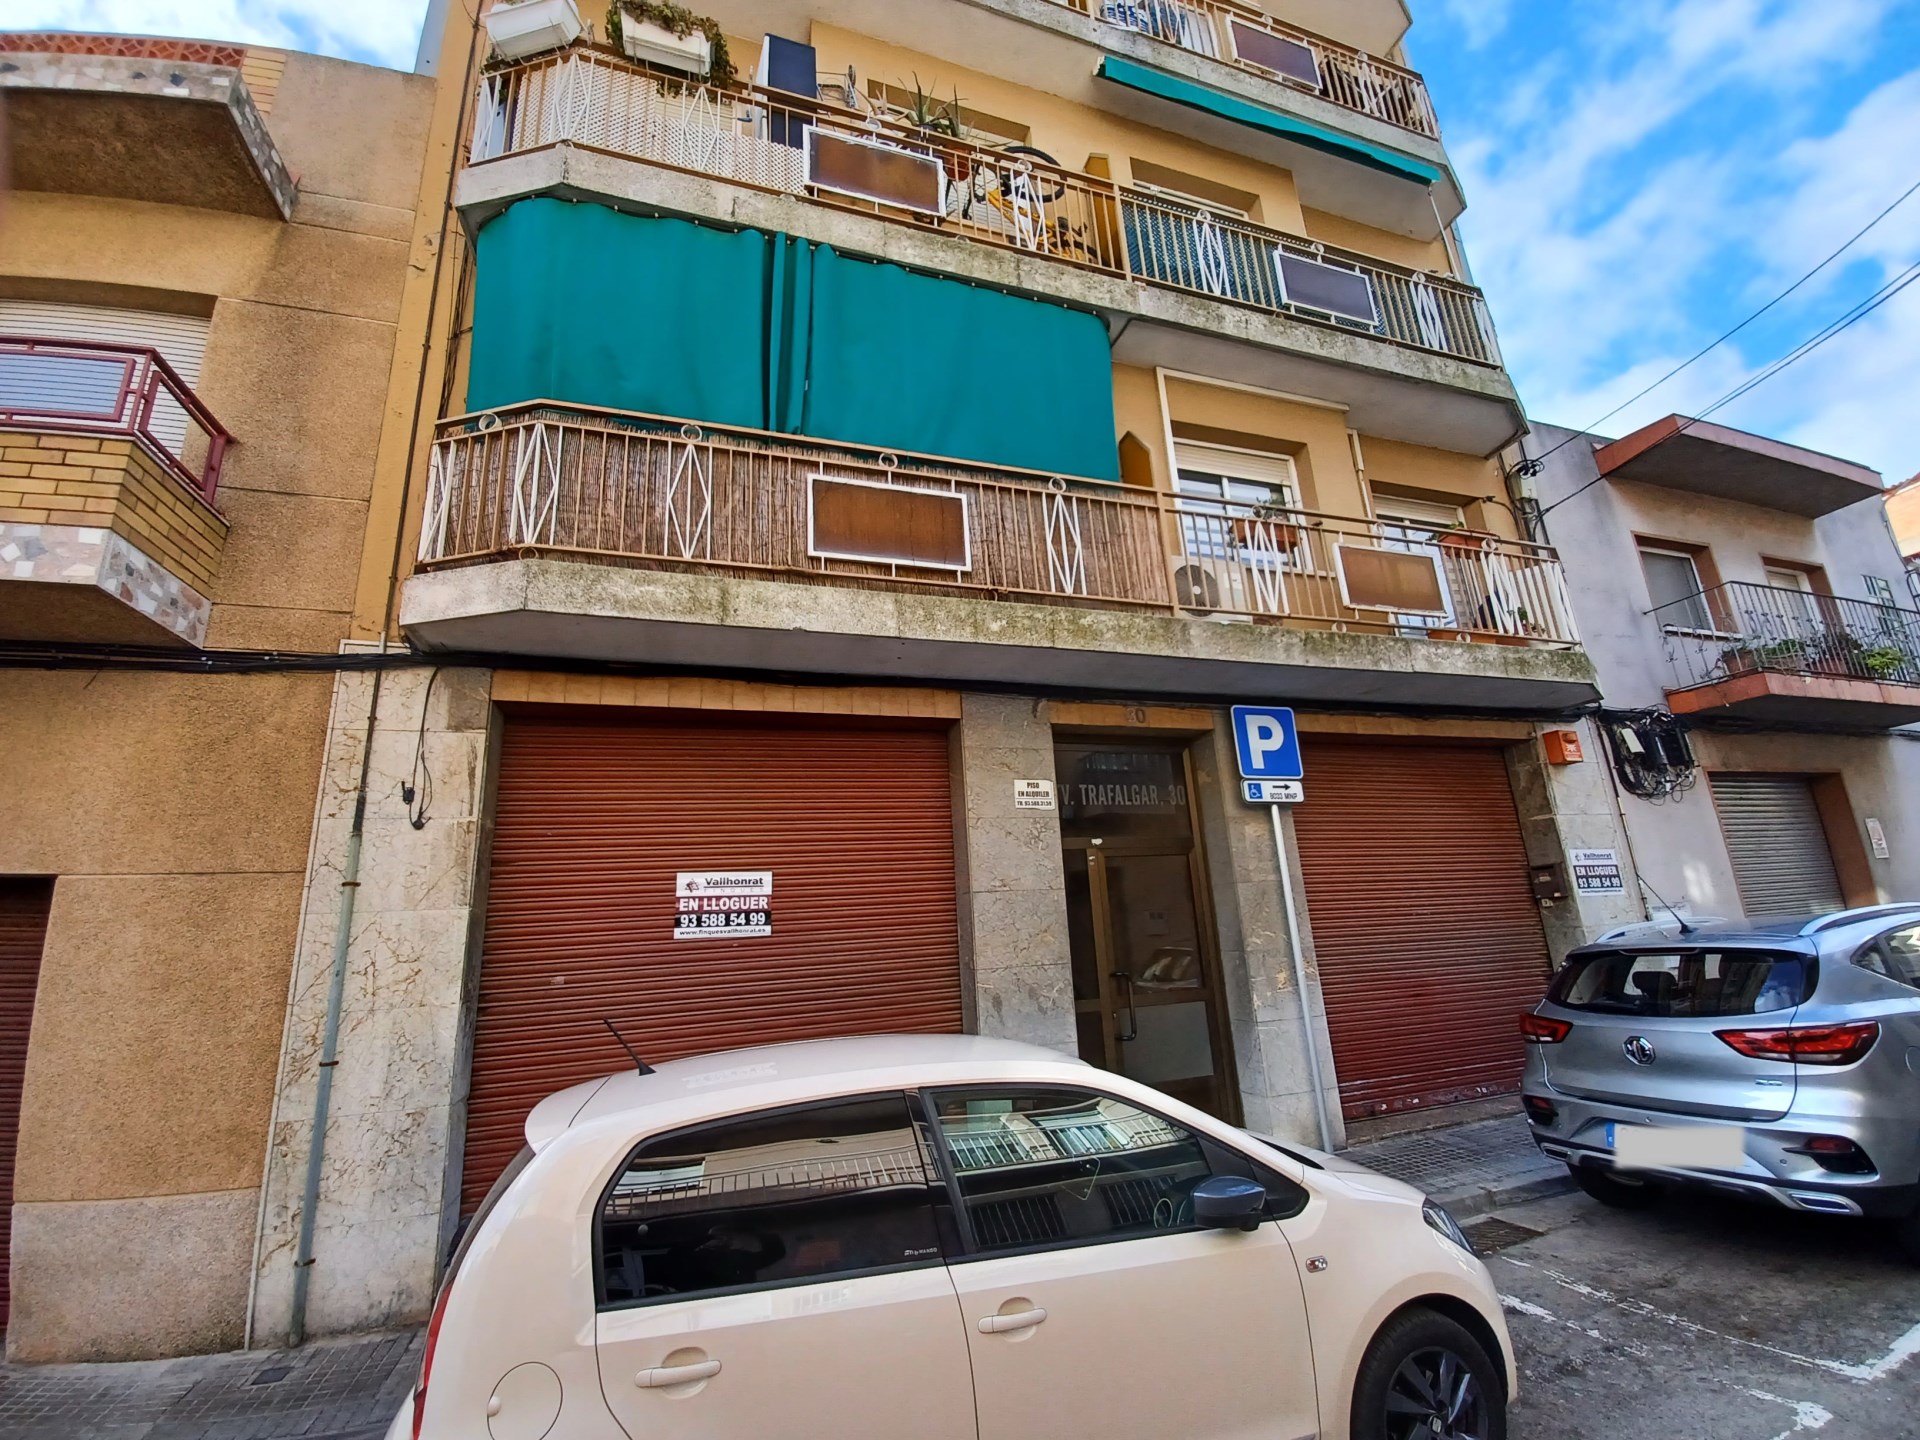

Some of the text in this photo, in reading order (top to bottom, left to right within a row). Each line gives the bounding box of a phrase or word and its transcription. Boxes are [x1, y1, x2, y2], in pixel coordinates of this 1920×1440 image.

[1244, 714, 1285, 769] P
[1058, 784, 1075, 805] V.
[1168, 785, 1186, 806] 30
[1575, 866, 1618, 876] EN LLOGUER
[704, 877, 764, 886] Vallhonrat
[1578, 877, 1621, 888] 93 588 54 99
[679, 896, 768, 911] EN LLOGUER
[680, 912, 766, 927] 93 588 54 99
